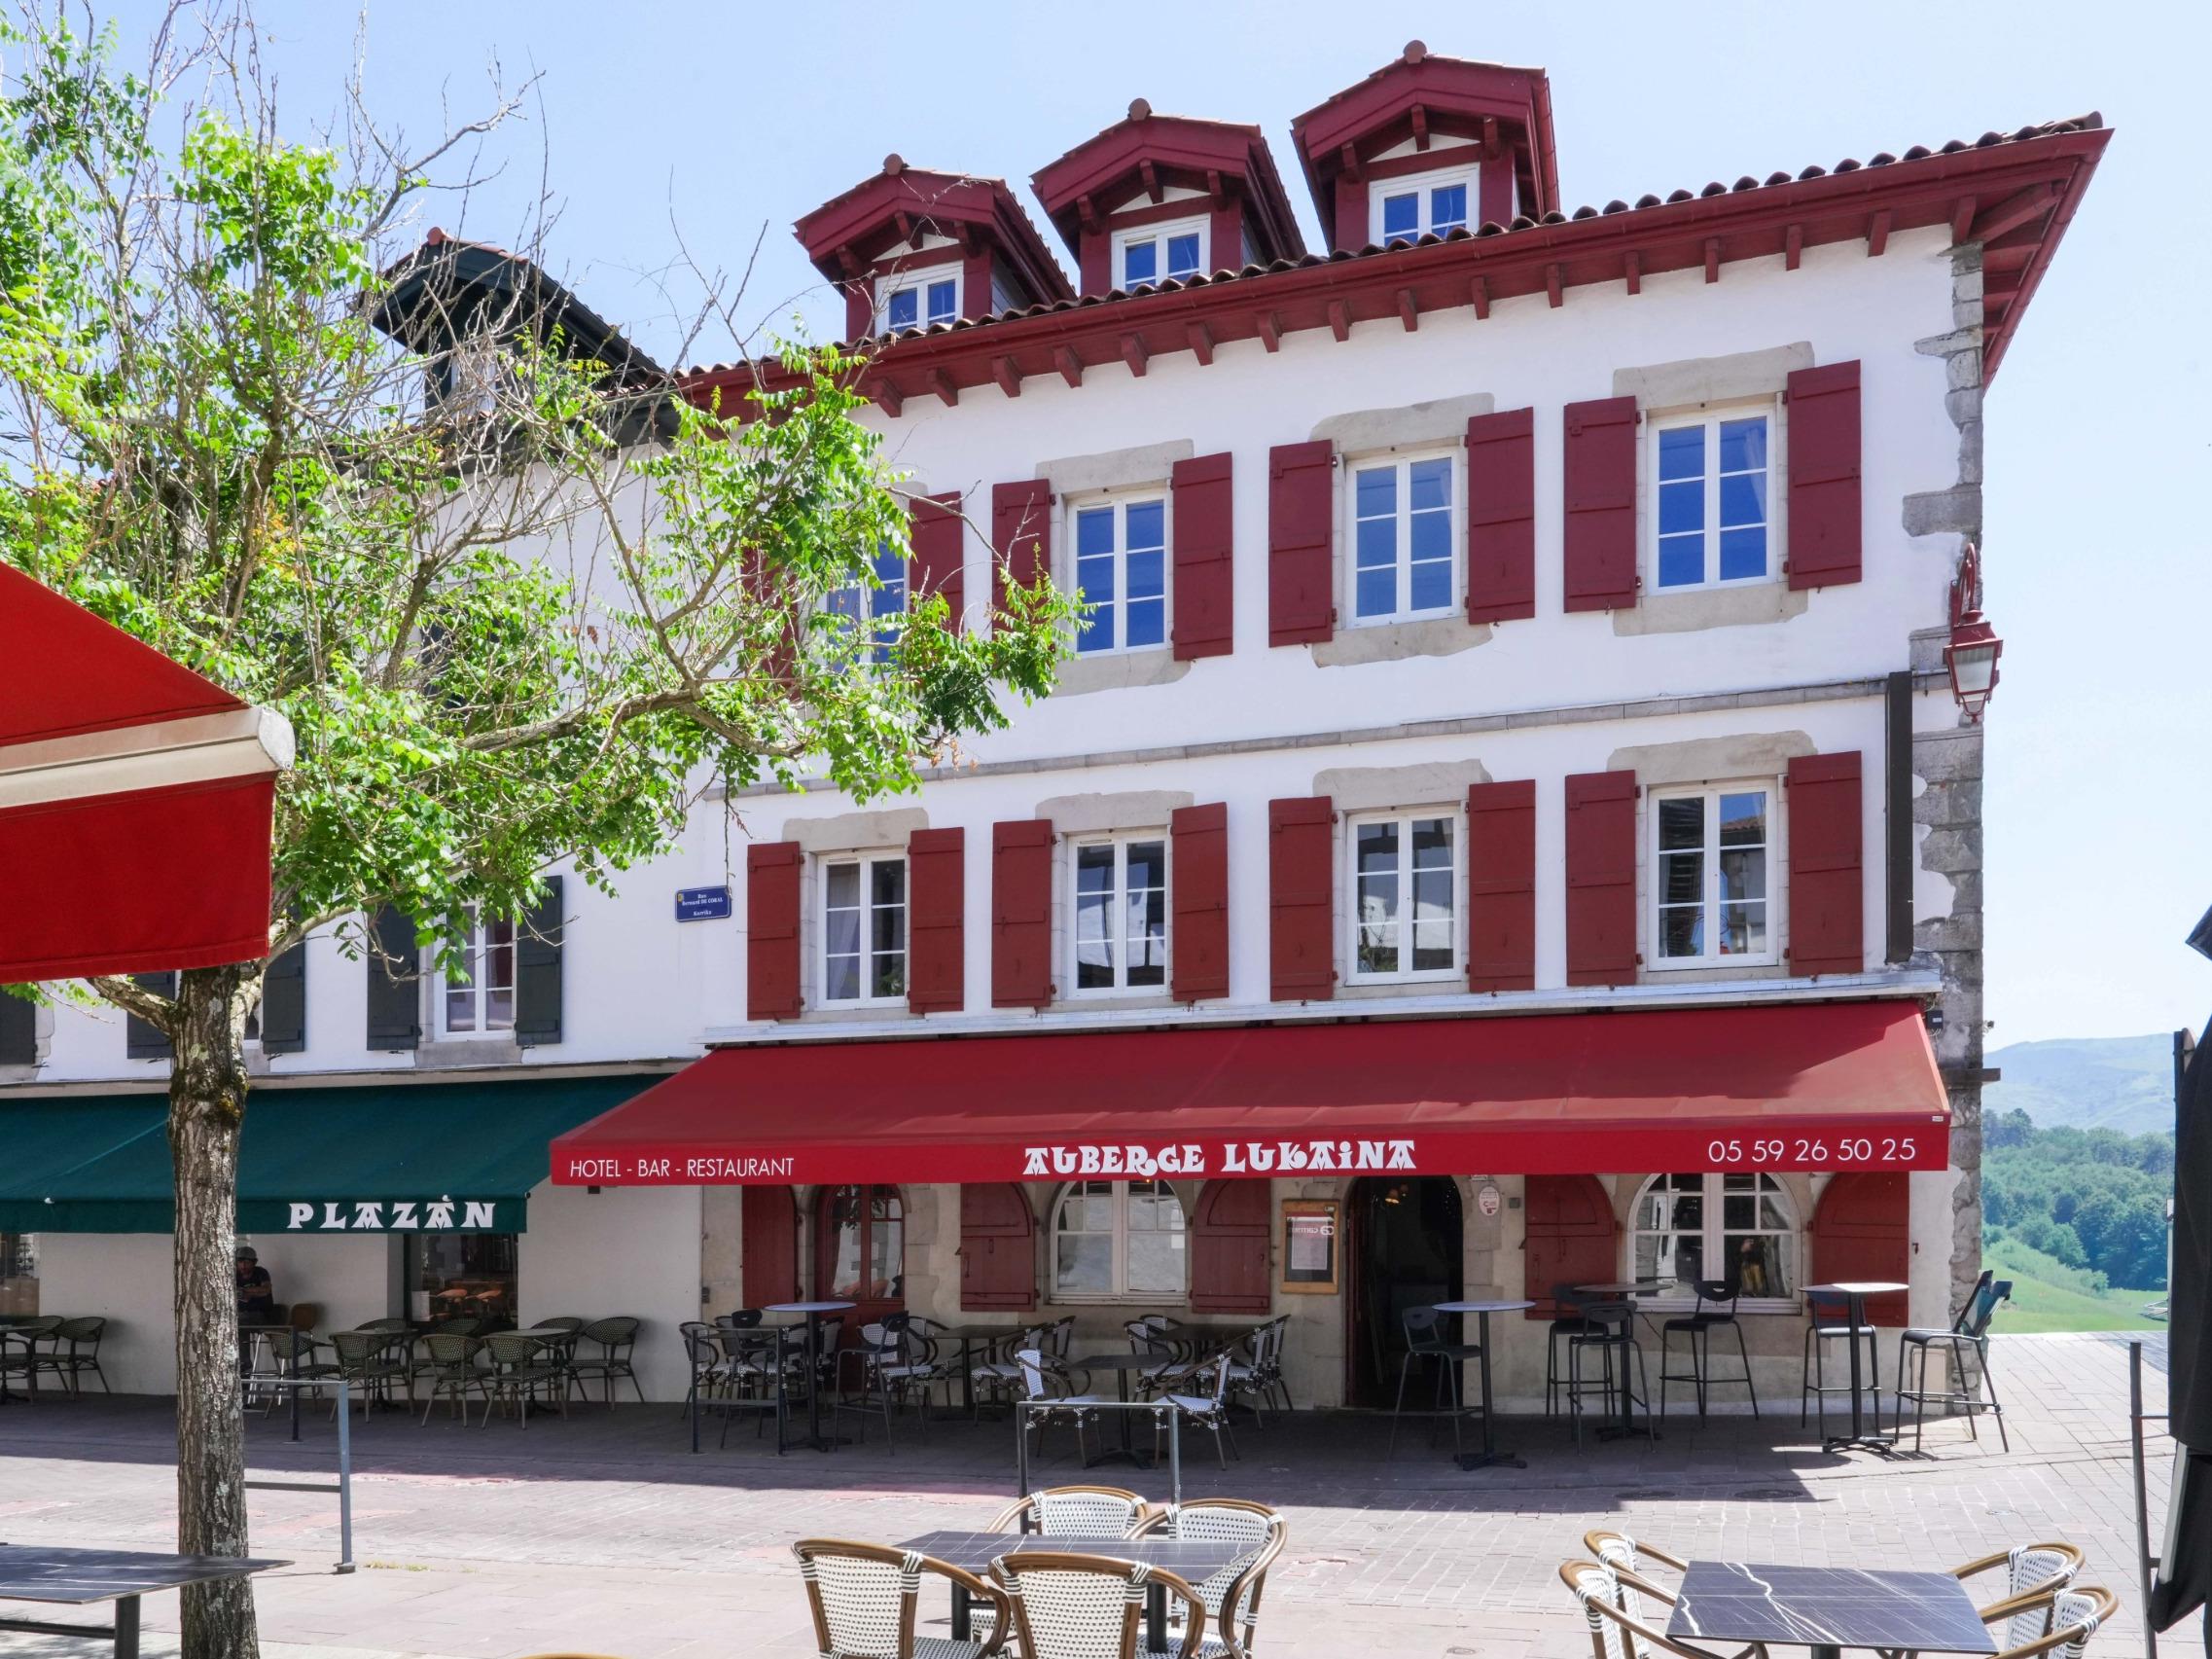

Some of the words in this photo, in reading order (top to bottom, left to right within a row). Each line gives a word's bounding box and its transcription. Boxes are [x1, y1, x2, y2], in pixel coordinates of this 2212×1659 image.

[1022, 1143, 1205, 1176] AUBERGE
[1708, 1139, 1742, 1163] 05
[1751, 1139, 1784, 1163] 59
[1795, 1138, 1828, 1162] 26
[1837, 1138, 1872, 1161] 50
[1881, 1137, 1916, 1161] 25
[570, 1159, 621, 1177] HOTEL
[638, 1159, 670, 1177] BAR
[687, 1157, 795, 1177] RESTAURANT
